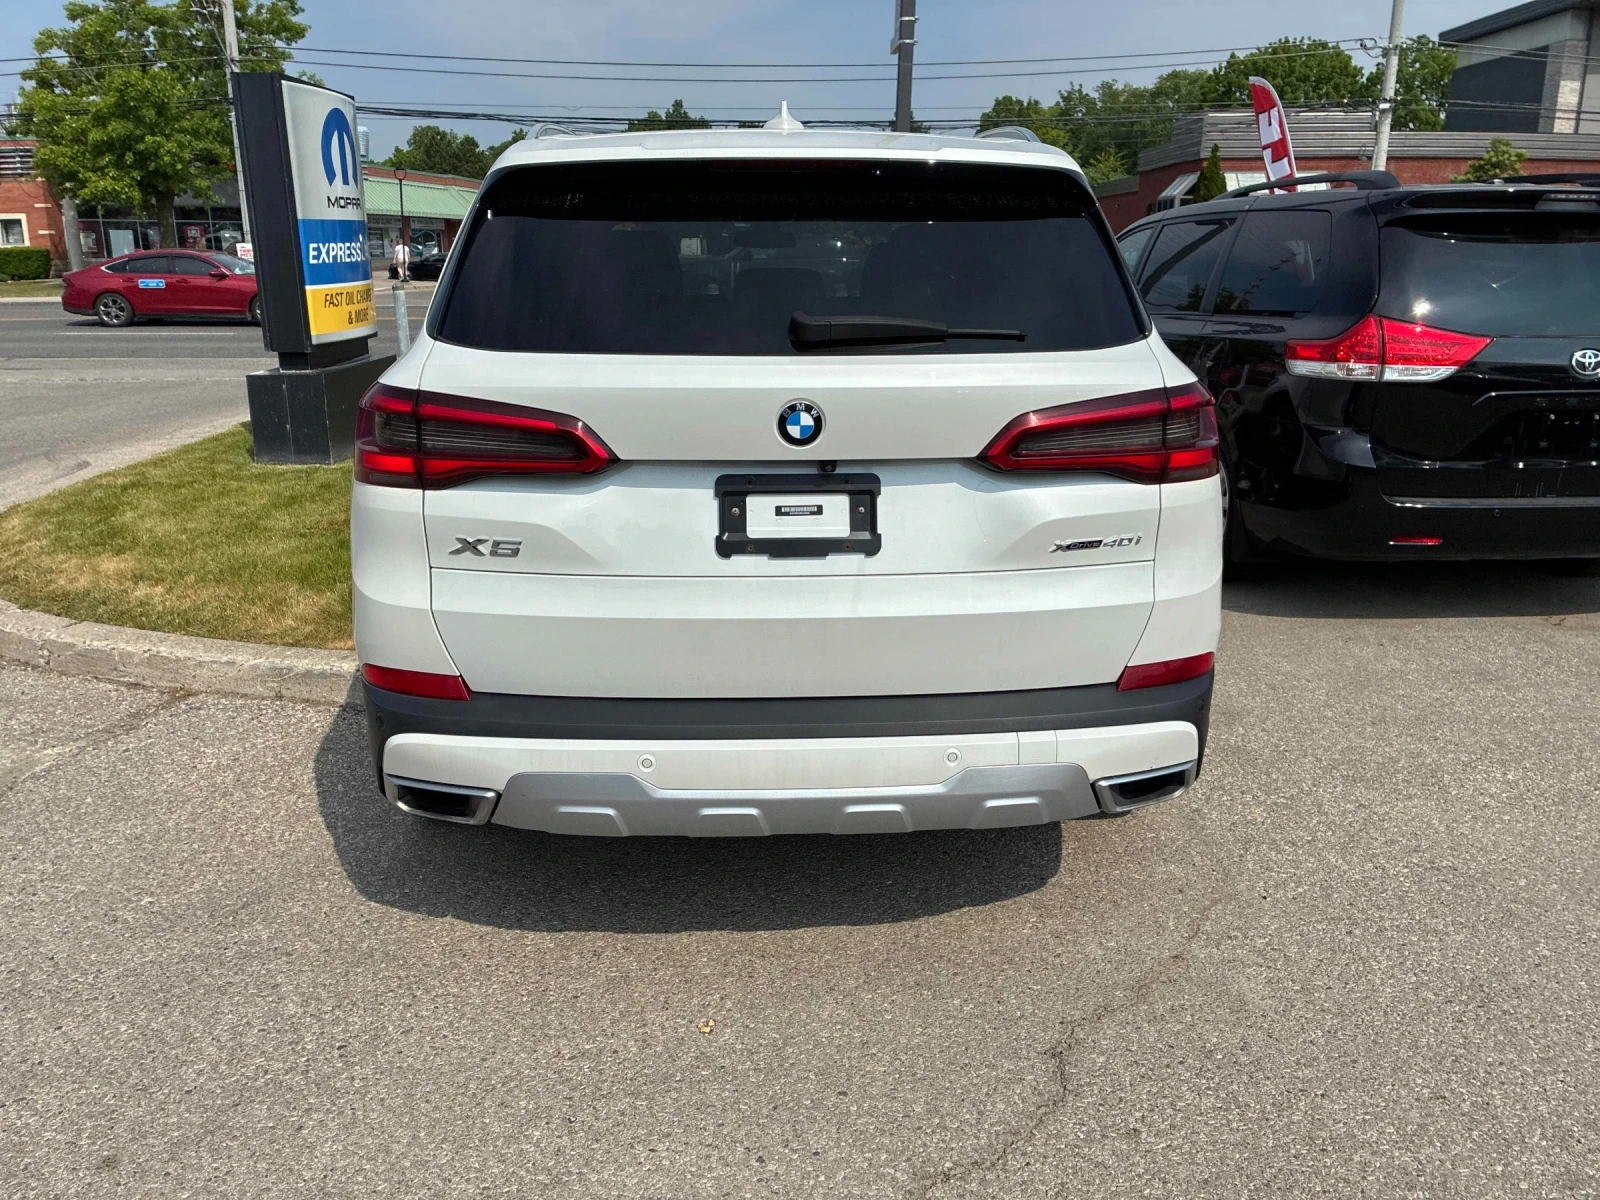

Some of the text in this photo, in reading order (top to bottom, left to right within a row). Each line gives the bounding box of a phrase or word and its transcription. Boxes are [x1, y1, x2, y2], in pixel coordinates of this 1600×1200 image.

[327, 195, 361, 210] MOPAR
[324, 292, 344, 308] FAST
[346, 290, 355, 306] OIL
[348, 307, 369, 325] & MORE
[783, 403, 819, 418] BMW
[447, 535, 522, 558] X5
